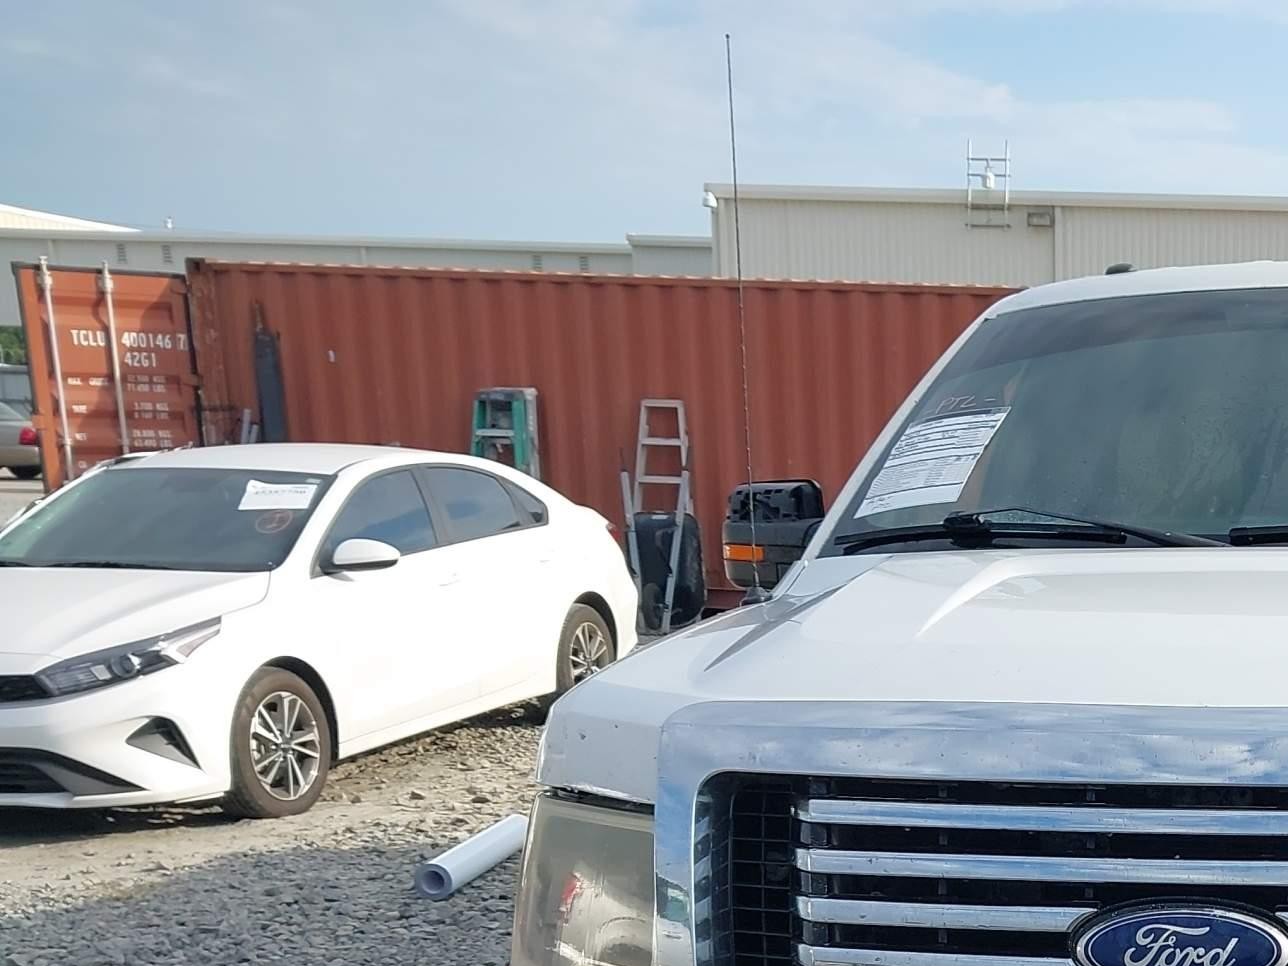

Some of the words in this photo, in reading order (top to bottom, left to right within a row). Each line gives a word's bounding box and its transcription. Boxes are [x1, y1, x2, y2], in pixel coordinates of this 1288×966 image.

[70, 329, 106, 346] TCLU
[121, 331, 172, 349] 400146
[124, 351, 157, 367] 42G1
